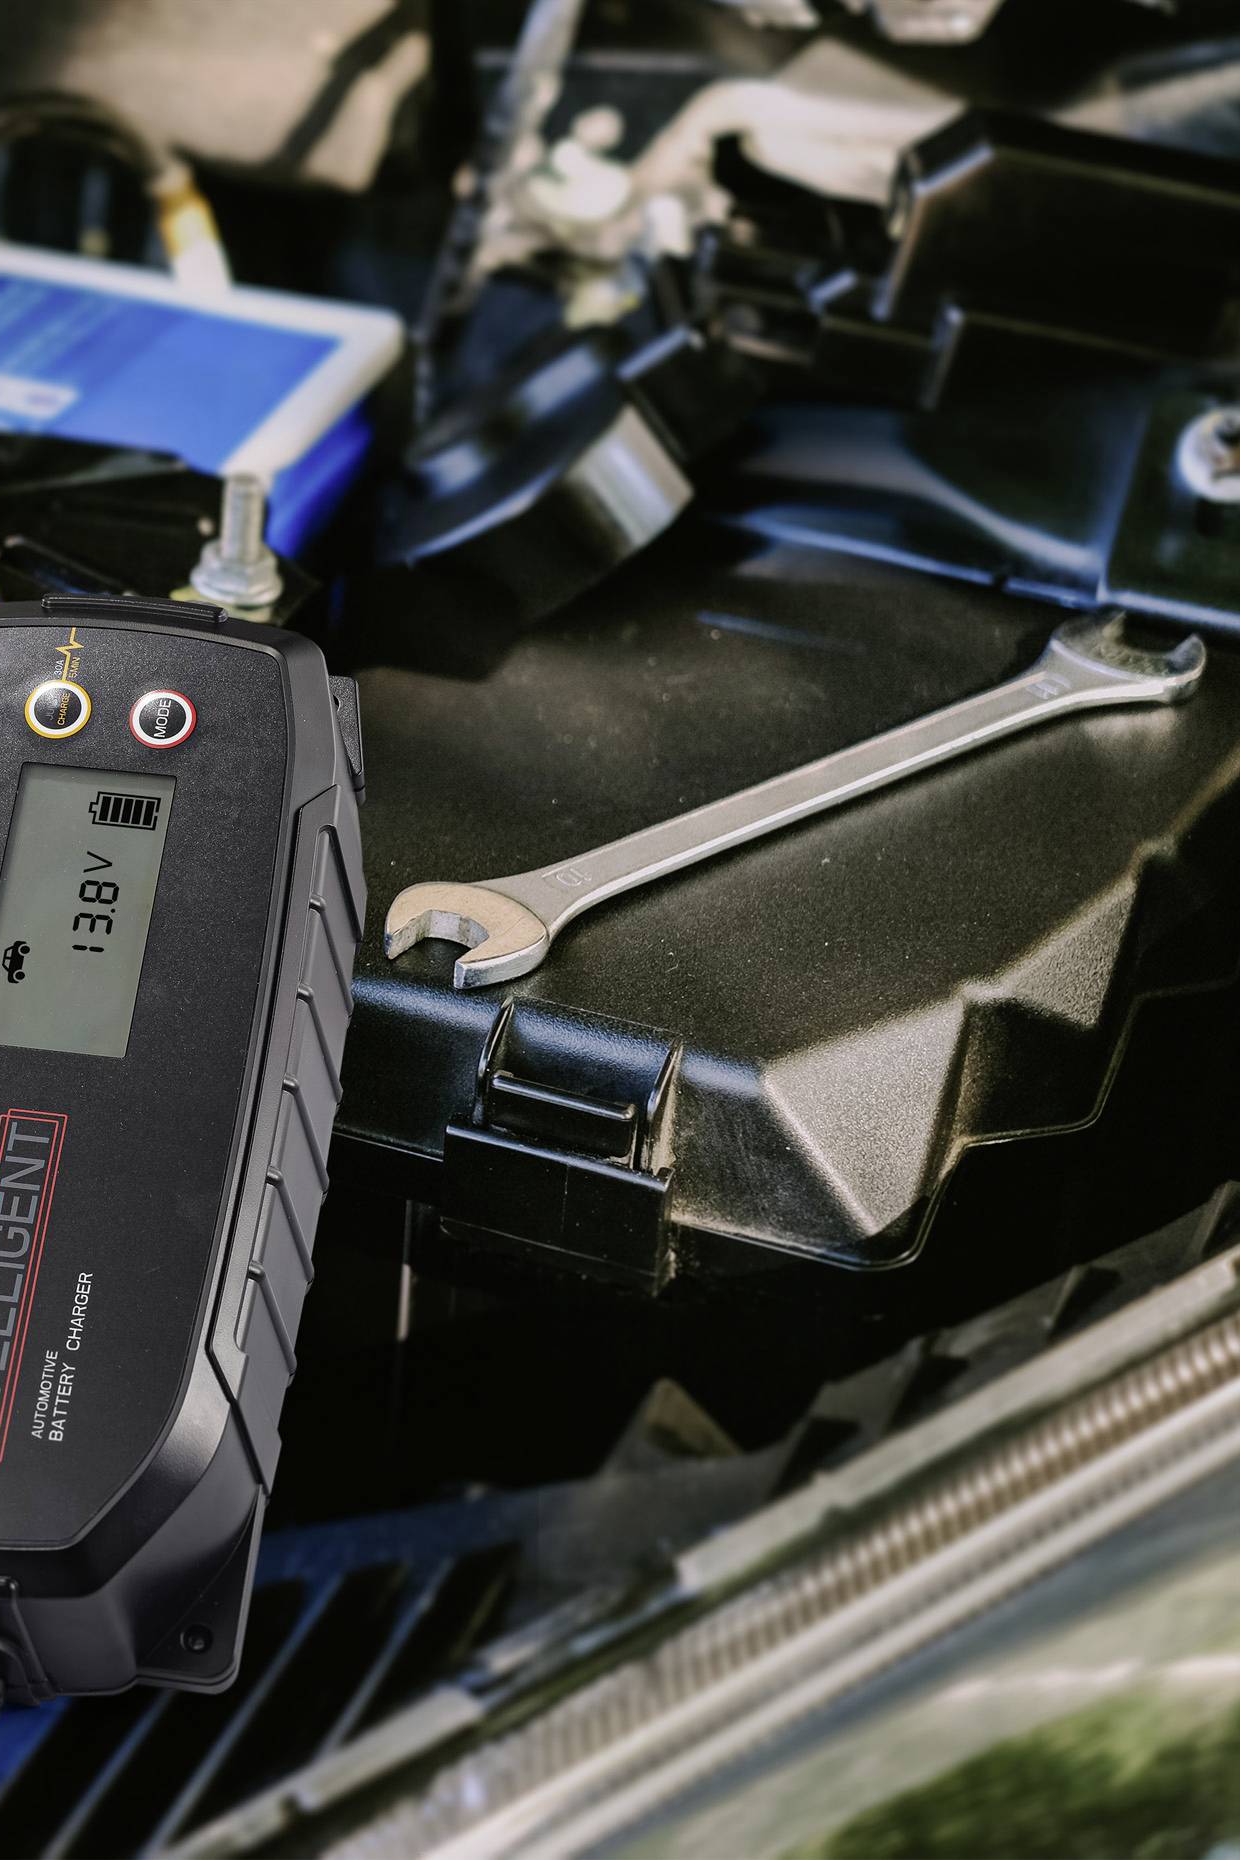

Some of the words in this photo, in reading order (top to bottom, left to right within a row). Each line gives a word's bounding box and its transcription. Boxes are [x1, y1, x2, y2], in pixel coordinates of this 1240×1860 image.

[57, 692, 71, 726] CHARGE
[153, 698, 172, 738] MODE
[83, 850, 113, 873] V
[71, 879, 119, 952] 13.8
[48, 1362, 76, 1442] BATTERY
[66, 1272, 93, 1351] CHARGER
[31, 1350, 58, 1439] AUTOMOTIVE
